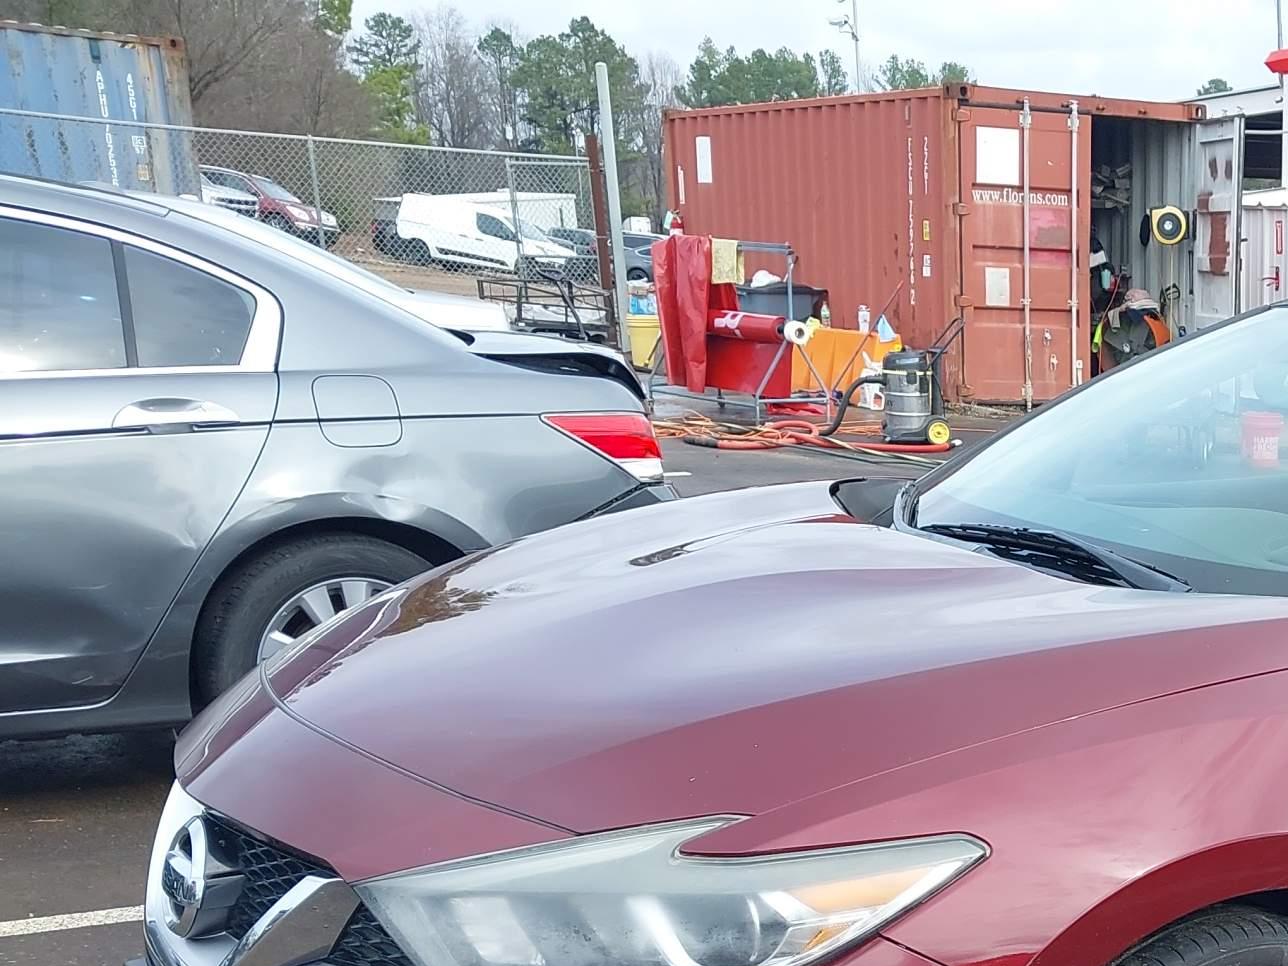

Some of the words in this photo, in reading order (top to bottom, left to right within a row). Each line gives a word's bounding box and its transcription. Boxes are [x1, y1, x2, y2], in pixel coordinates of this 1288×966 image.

[96, 70, 109, 118] APHU
[126, 73, 137, 120] 45G1
[971, 187, 1069, 206] www.florns.com
